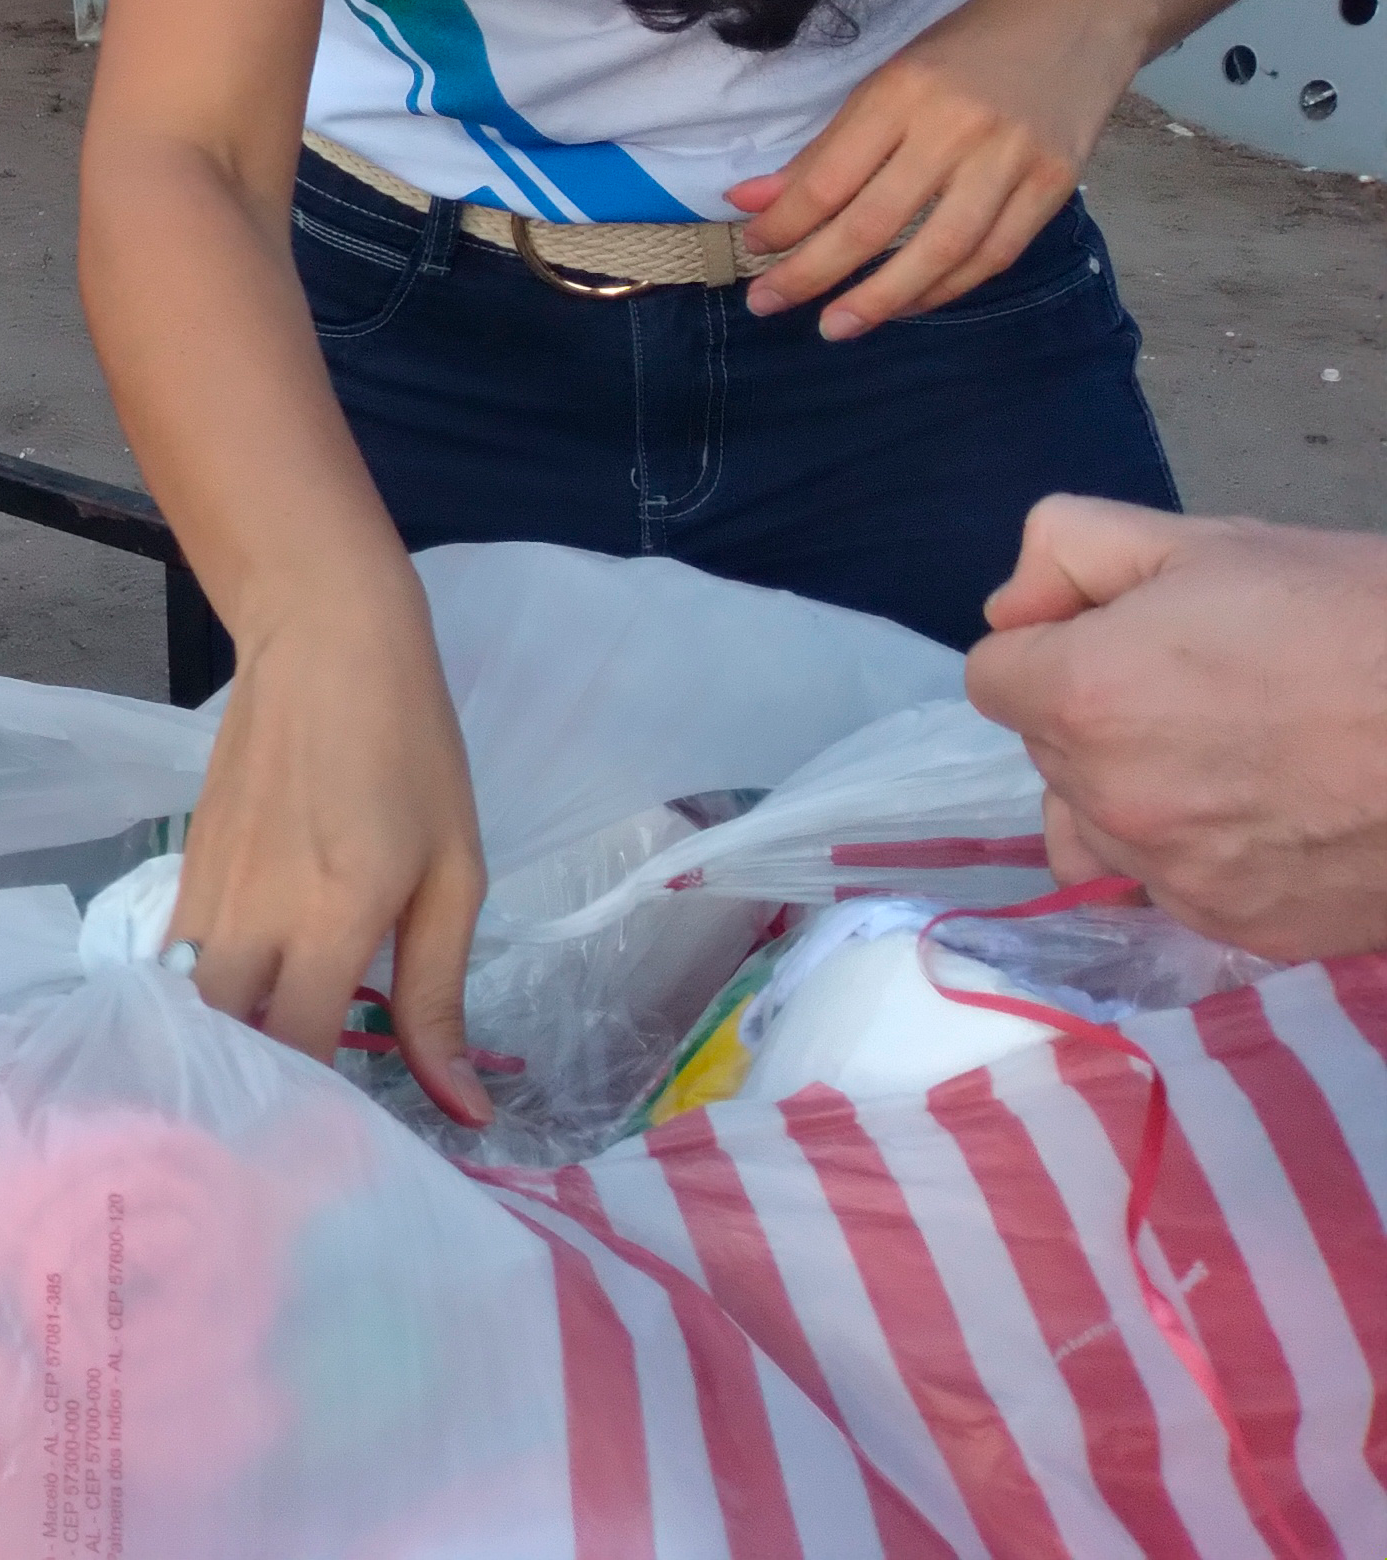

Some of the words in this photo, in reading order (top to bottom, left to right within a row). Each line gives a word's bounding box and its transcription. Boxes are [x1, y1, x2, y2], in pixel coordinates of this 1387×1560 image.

[107, 1290, 123, 1330] CEP
[107, 1349, 123, 1372] AL
[44, 1372, 60, 1414] CEP
[44, 1434, 59, 1456] AL
[108, 1447, 123, 1480] dos
[86, 1468, 102, 1511] CEP
[63, 1501, 79, 1544] CEP
[86, 1529, 100, 1554] AL
